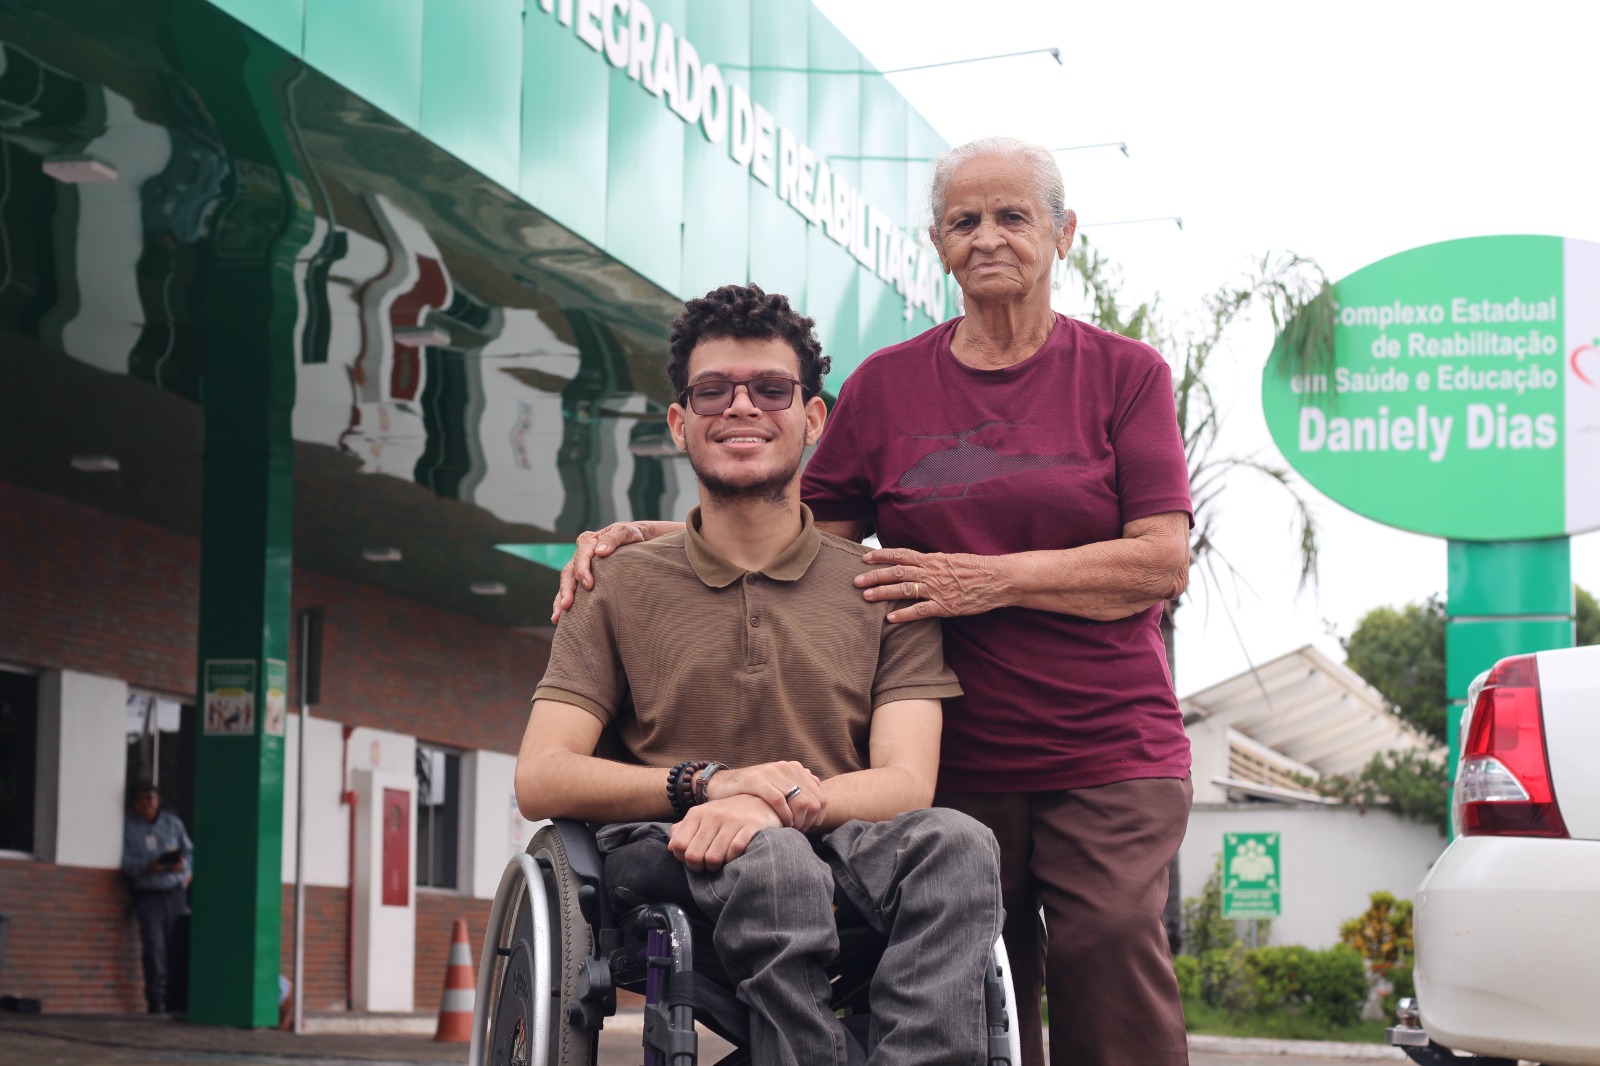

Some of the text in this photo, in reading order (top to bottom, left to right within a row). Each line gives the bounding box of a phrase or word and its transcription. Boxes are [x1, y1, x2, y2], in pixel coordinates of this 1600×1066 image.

[534, 0, 727, 143] EGRADO
[730, 84, 774, 187] DE
[1451, 297, 1557, 323] Estadual
[1371, 331, 1557, 361] de Reabilitação
[1335, 366, 1409, 393] Saúde
[1416, 372, 1431, 391] e
[1437, 365, 1557, 395] Educação
[1299, 403, 1558, 462] Daniely Dias
